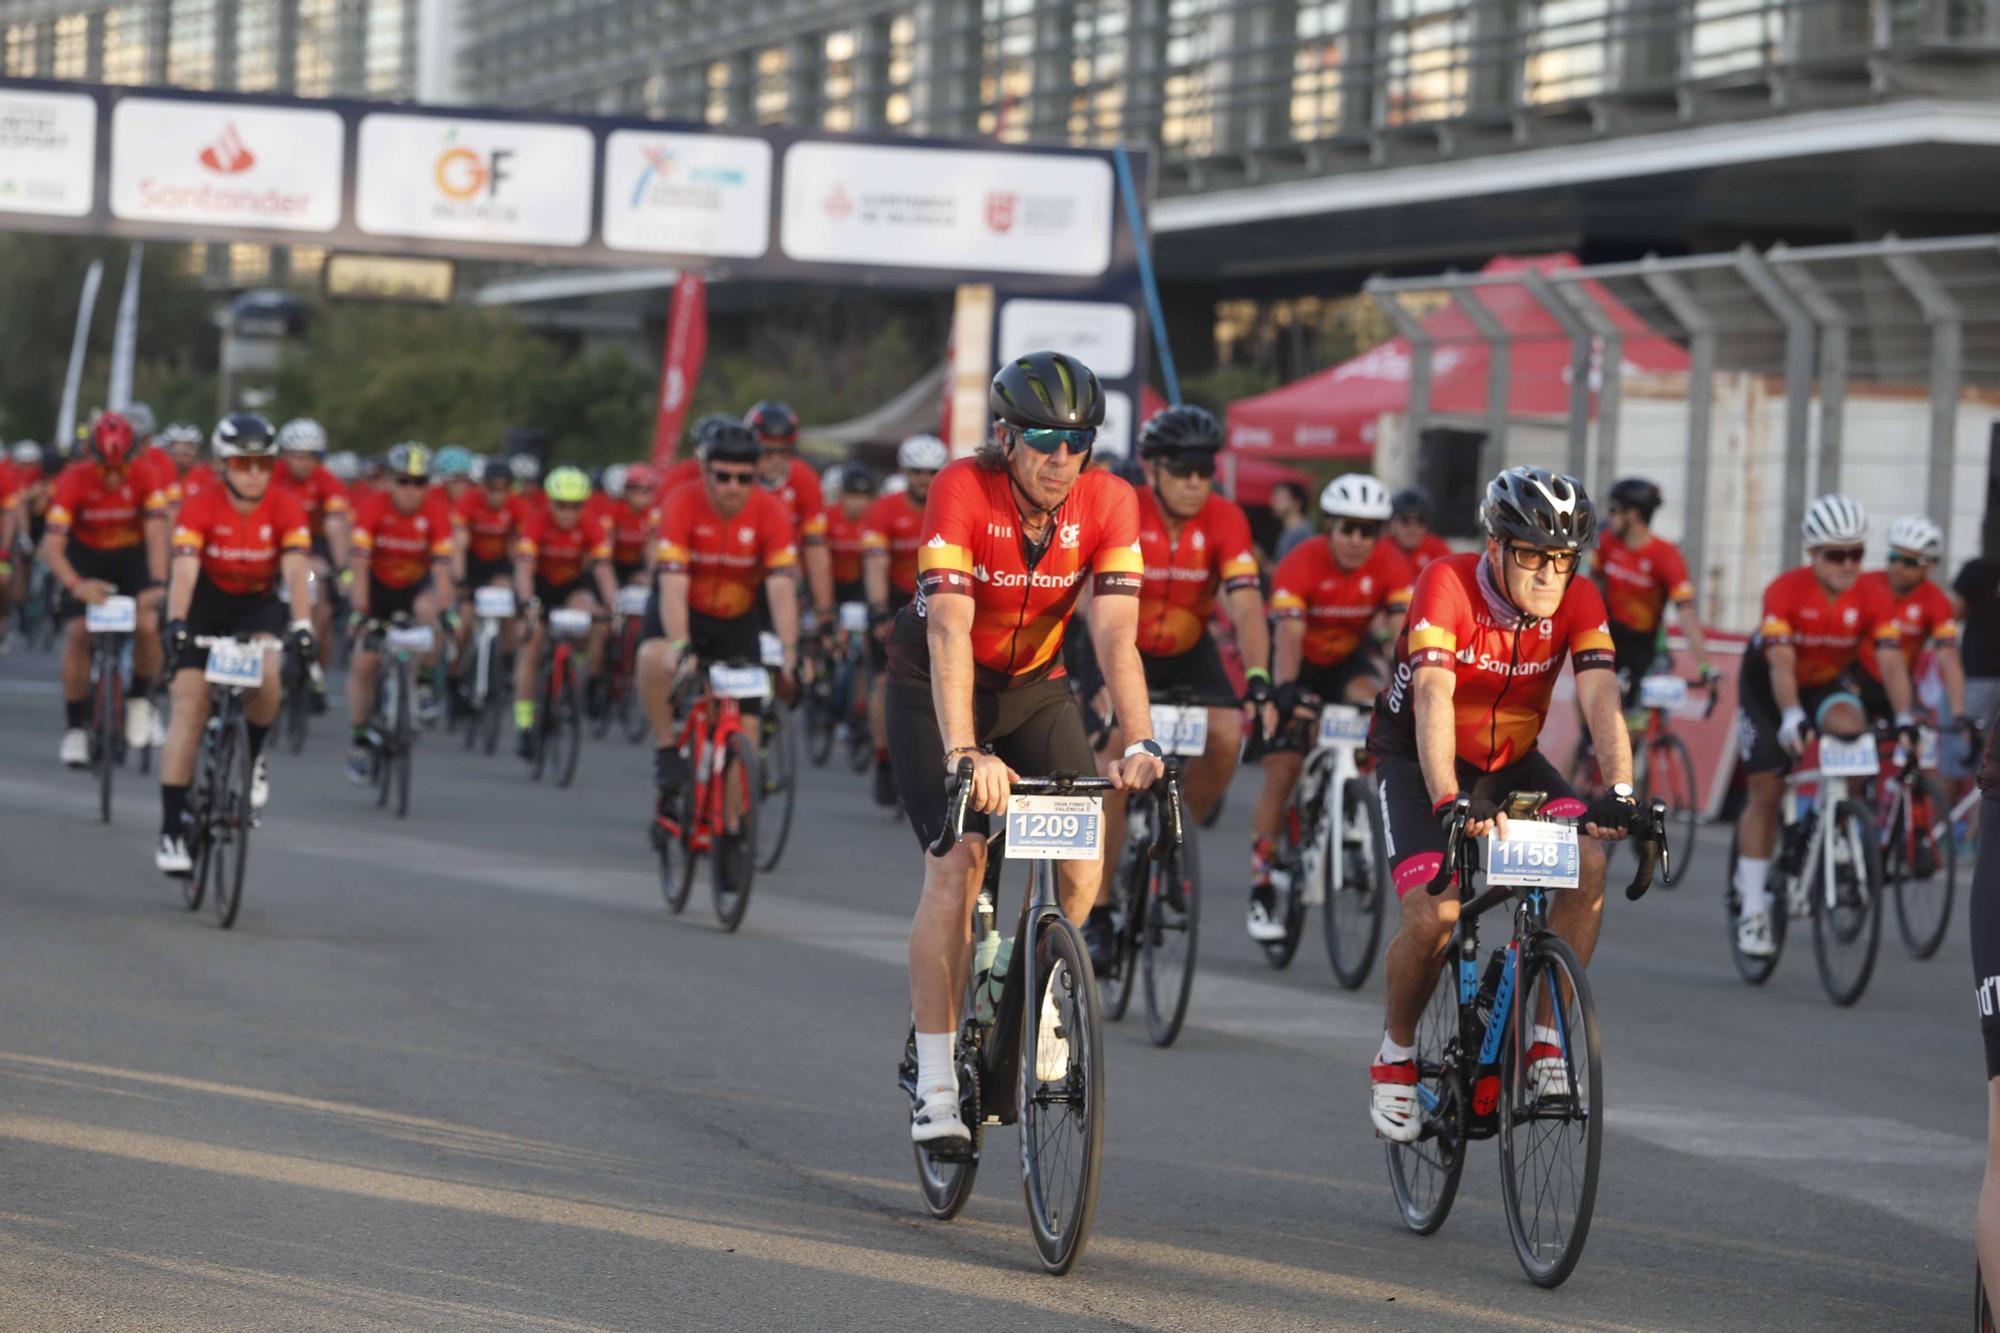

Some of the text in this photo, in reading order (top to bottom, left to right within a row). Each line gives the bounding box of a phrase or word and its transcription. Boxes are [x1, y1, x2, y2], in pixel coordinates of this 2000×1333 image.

[137, 177, 310, 218] Santander
[1015, 814, 1079, 838] 1209
[1086, 816, 1096, 829] km
[1497, 841, 1559, 867] 1158
[1567, 845, 1576, 859] km
